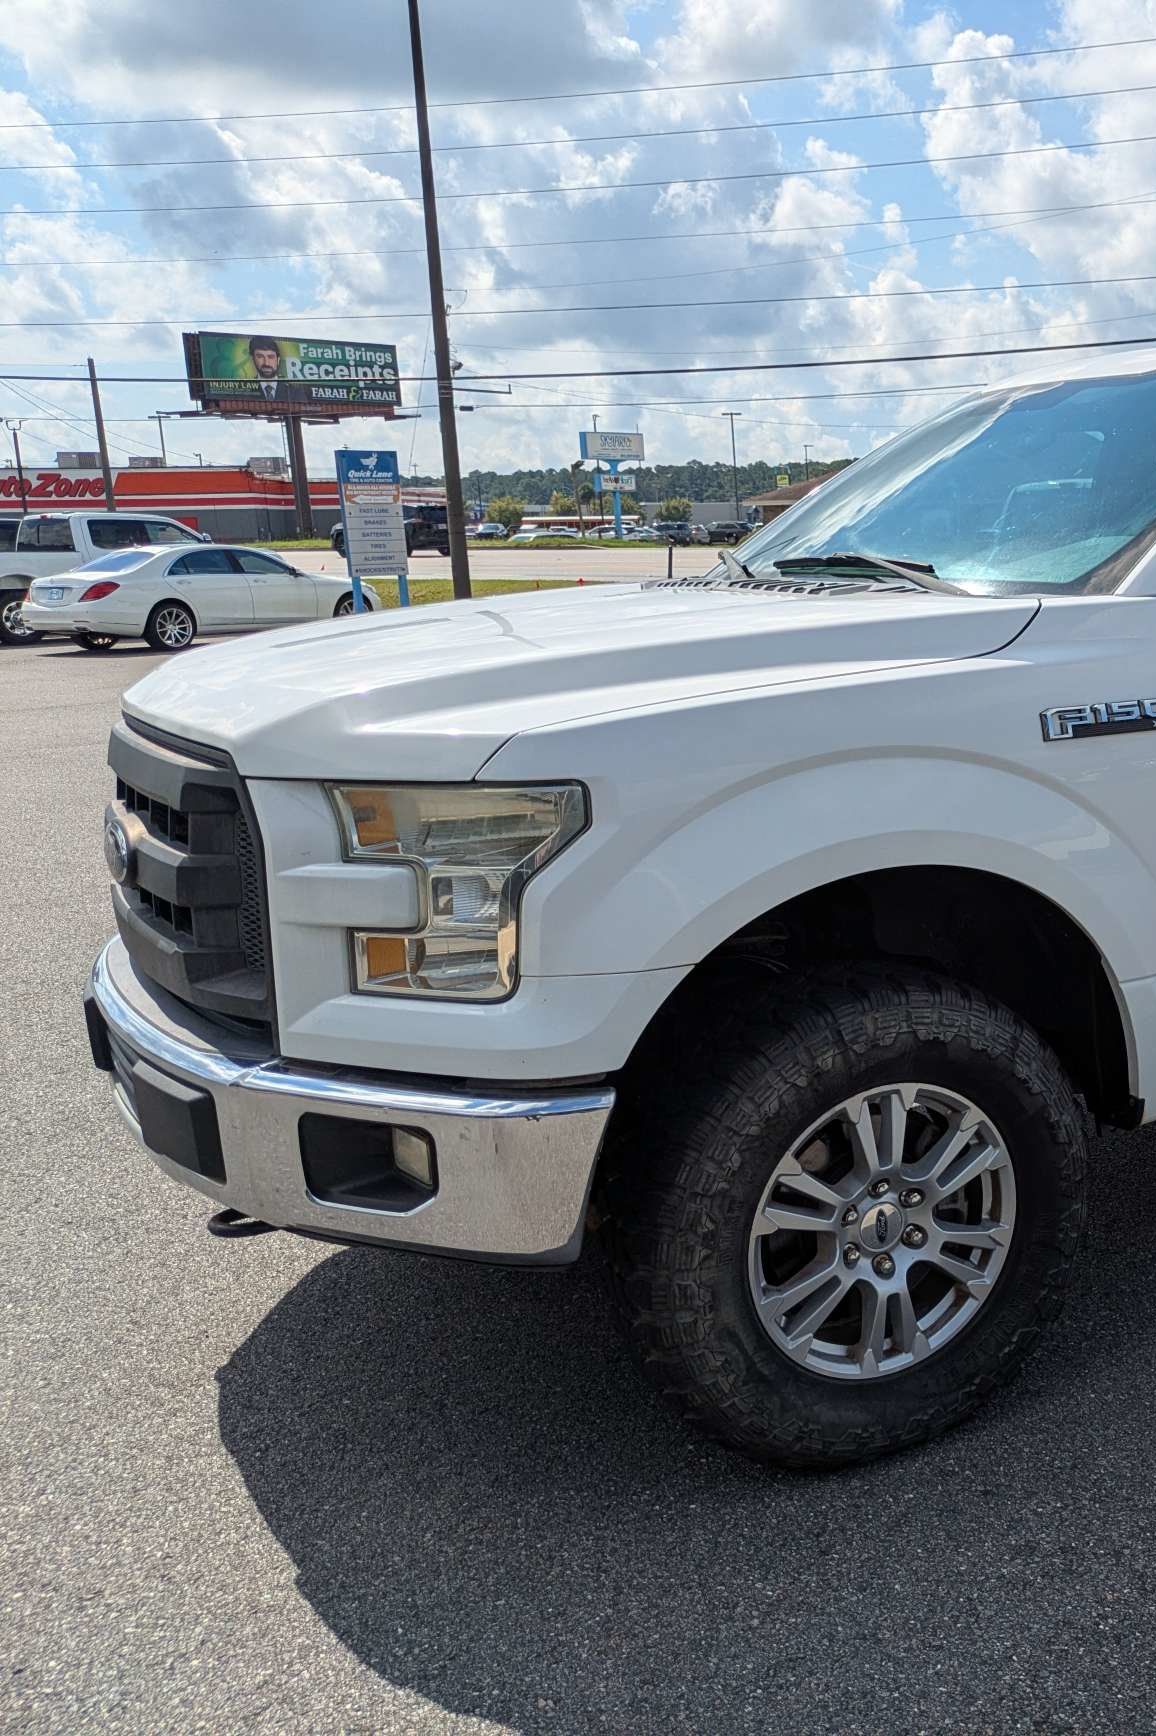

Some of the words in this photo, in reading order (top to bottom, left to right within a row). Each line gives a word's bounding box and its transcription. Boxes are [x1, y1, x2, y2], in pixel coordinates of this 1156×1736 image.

[299, 343, 342, 360] Farah
[345, 346, 393, 366] Brings
[285, 358, 396, 387] Receipts
[241, 382, 259, 390] LAW
[312, 387, 348, 399] FARAH
[363, 390, 397, 401] FARAH
[348, 469, 370, 478] Quick
[372, 470, 393, 478] Lane
